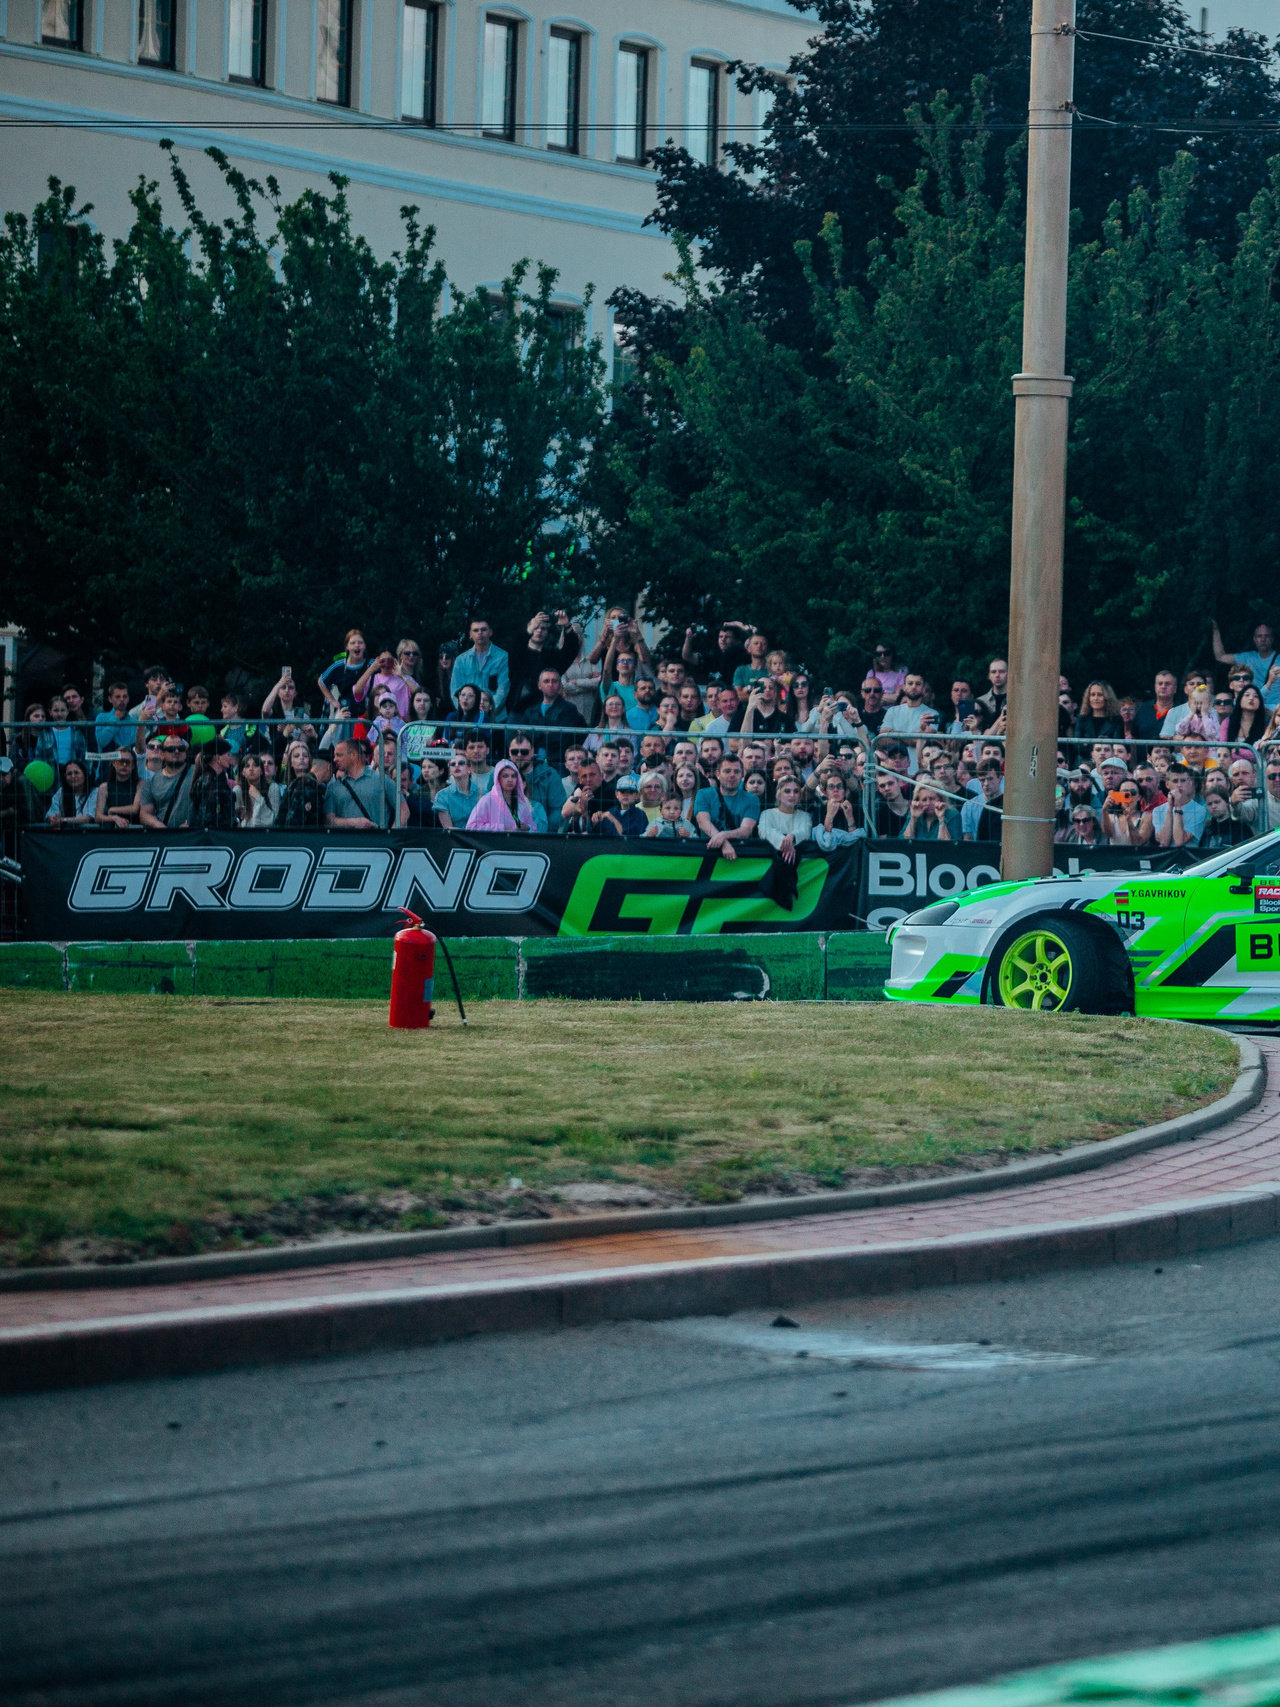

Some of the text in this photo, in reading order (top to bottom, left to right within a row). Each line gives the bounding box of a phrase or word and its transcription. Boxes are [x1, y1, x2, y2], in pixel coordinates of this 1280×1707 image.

[68, 846, 551, 913] GRODNO
[556, 854, 829, 937] GP
[1131, 889, 1188, 899] Y.GAVRIKOV
